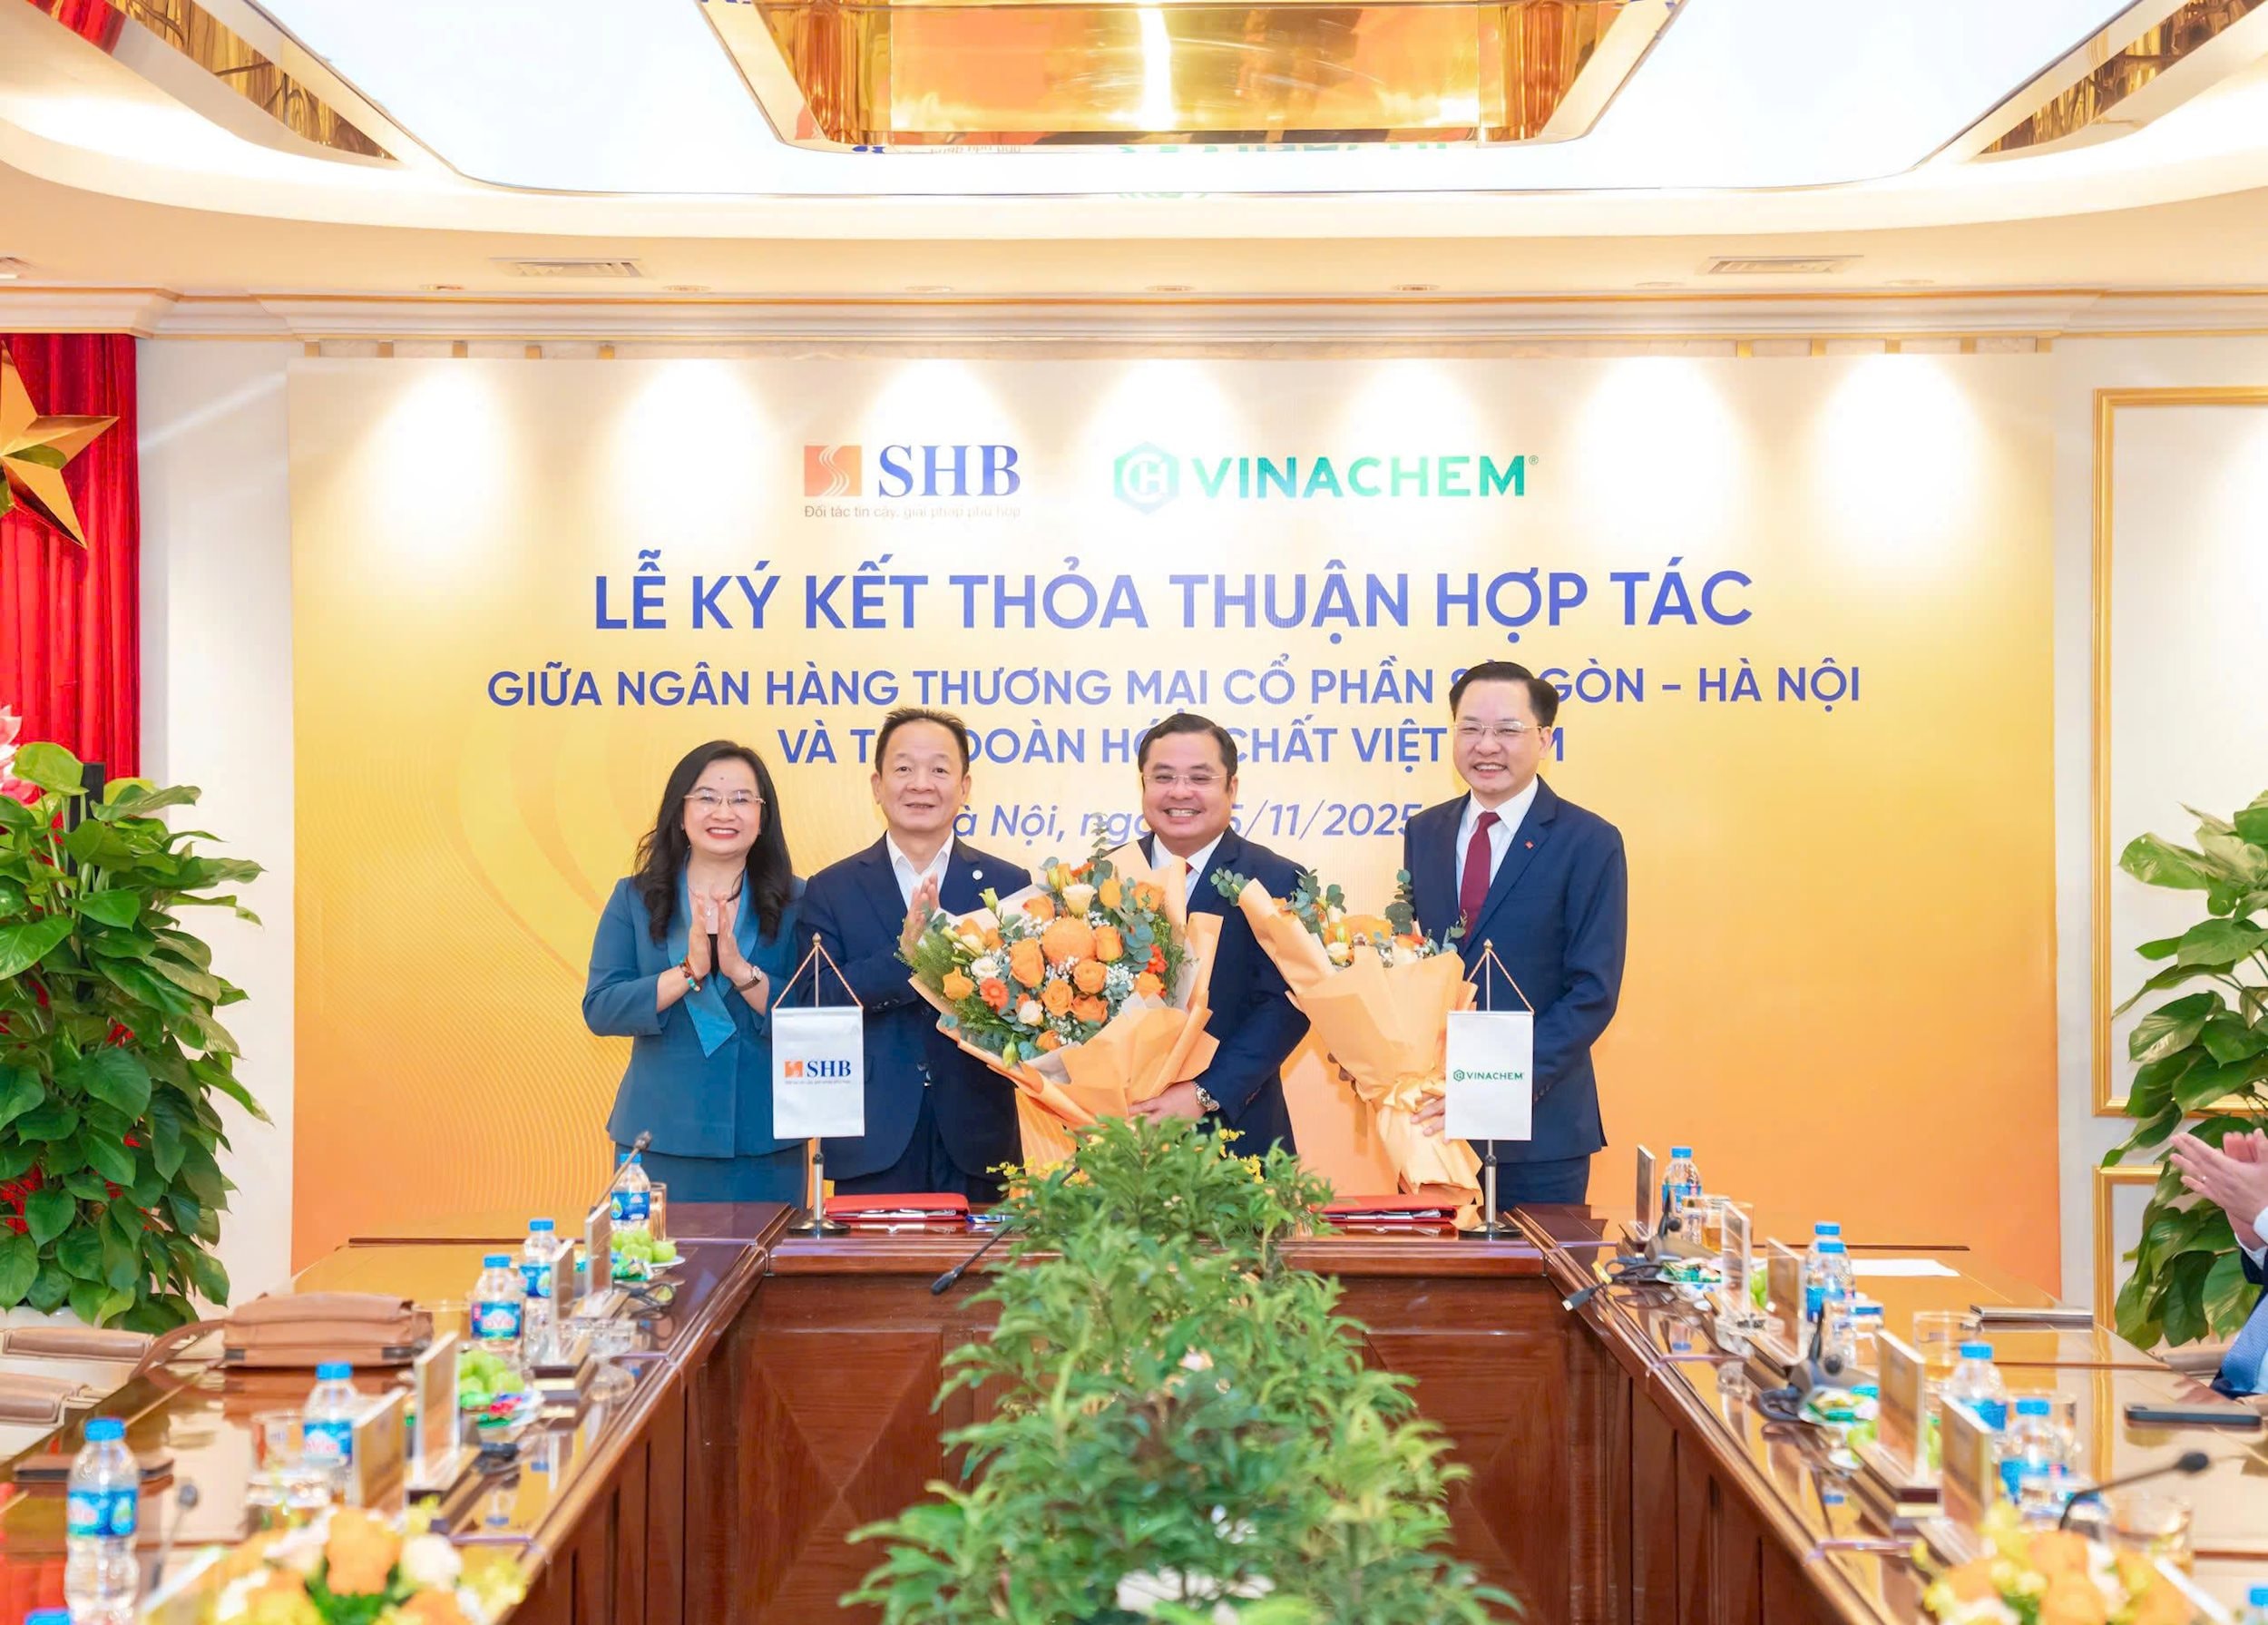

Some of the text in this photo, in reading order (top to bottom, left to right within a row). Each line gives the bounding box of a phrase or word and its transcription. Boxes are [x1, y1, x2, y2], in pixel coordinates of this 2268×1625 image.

[878, 445, 1021, 498] SHB
[596, 549, 1754, 644] LỄ KÝ KẾT THỎA THUẬN HỢP TÁC
[487, 661, 601, 706] GIỮA
[618, 662, 748, 706] NGÂN
[767, 661, 899, 706] HÀNG
[914, 667, 1111, 706] THƯƠNG
[1224, 652, 1295, 705] CỔ
[1311, 655, 1434, 704] PHẦN
[1699, 658, 1761, 702] HÀ
[1778, 657, 1860, 712] NỘI
[777, 720, 839, 764] VÀ
[1351, 719, 1448, 773] VIỆT
[953, 805, 978, 837] à
[990, 804, 1066, 846] Nội,
[1230, 799, 1422, 840] 5/11/2025
[807, 1060, 851, 1078] SHB
